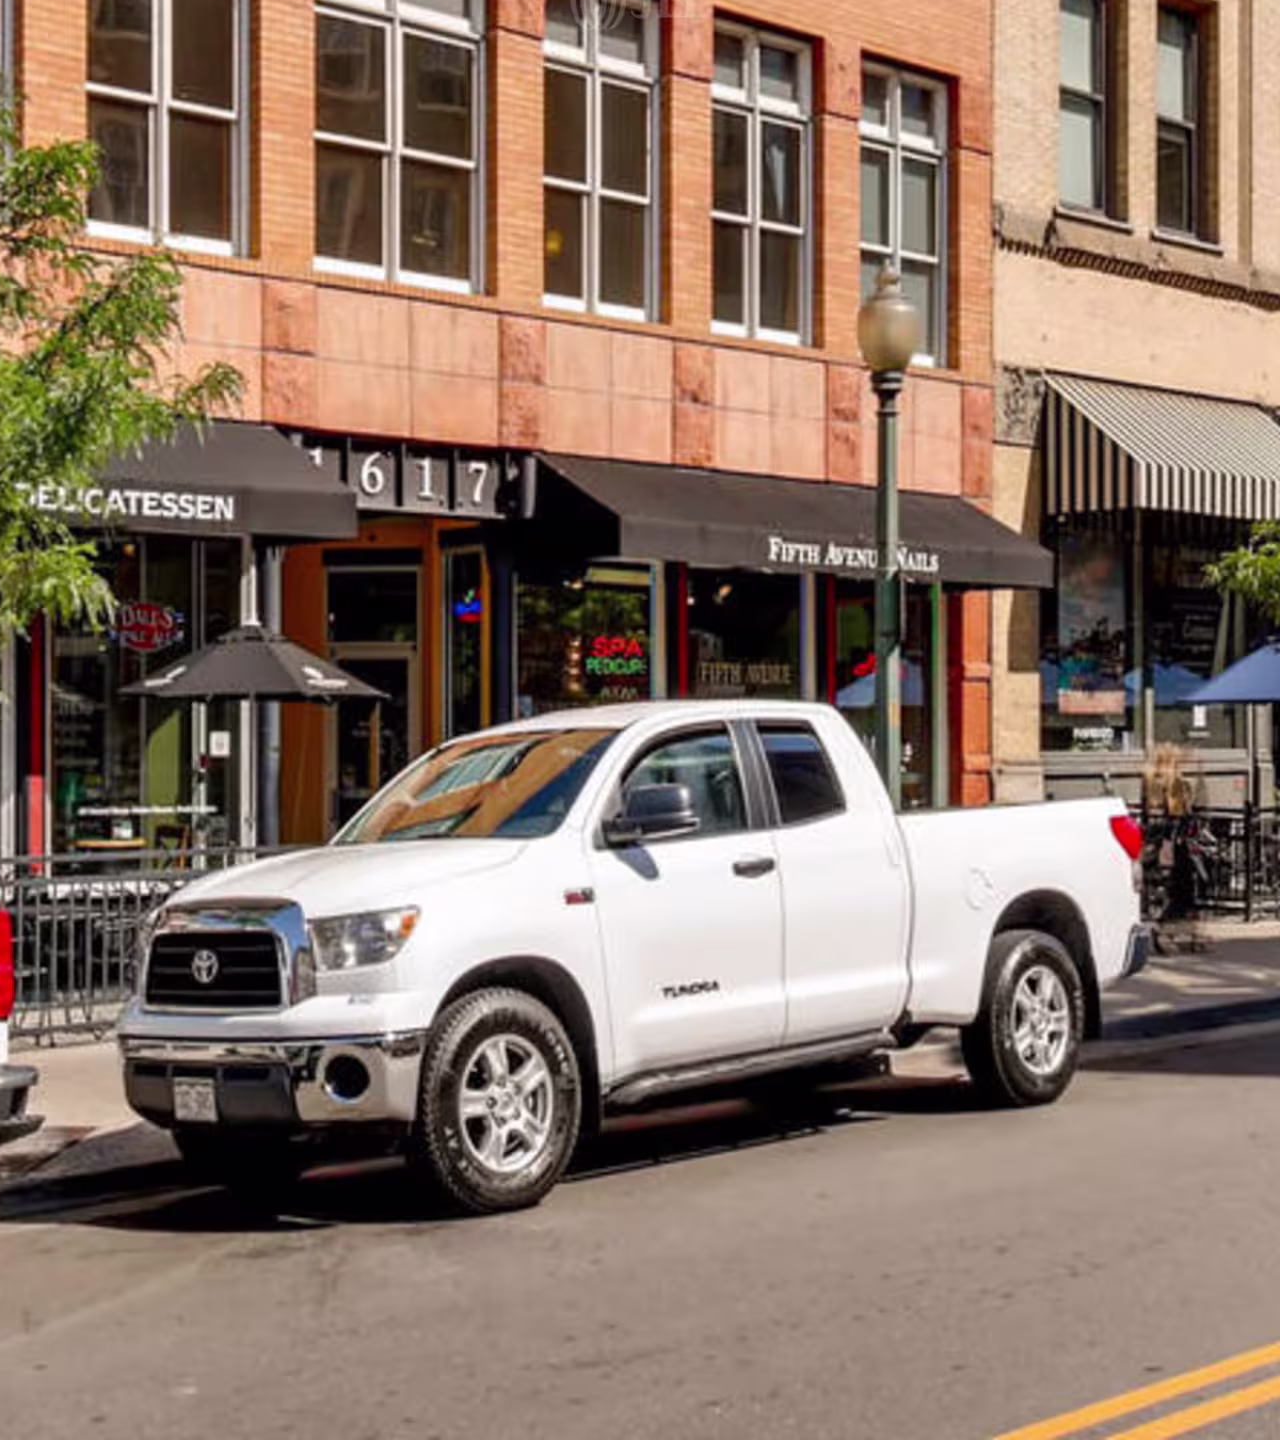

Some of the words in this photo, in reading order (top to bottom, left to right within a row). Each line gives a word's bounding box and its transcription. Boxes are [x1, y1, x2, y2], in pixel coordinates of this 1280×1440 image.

[769, 536, 820, 565] FIFTH
[825, 541, 878, 569] AVENU
[897, 546, 939, 572] NAILS
[591, 636, 644, 657] SPA
